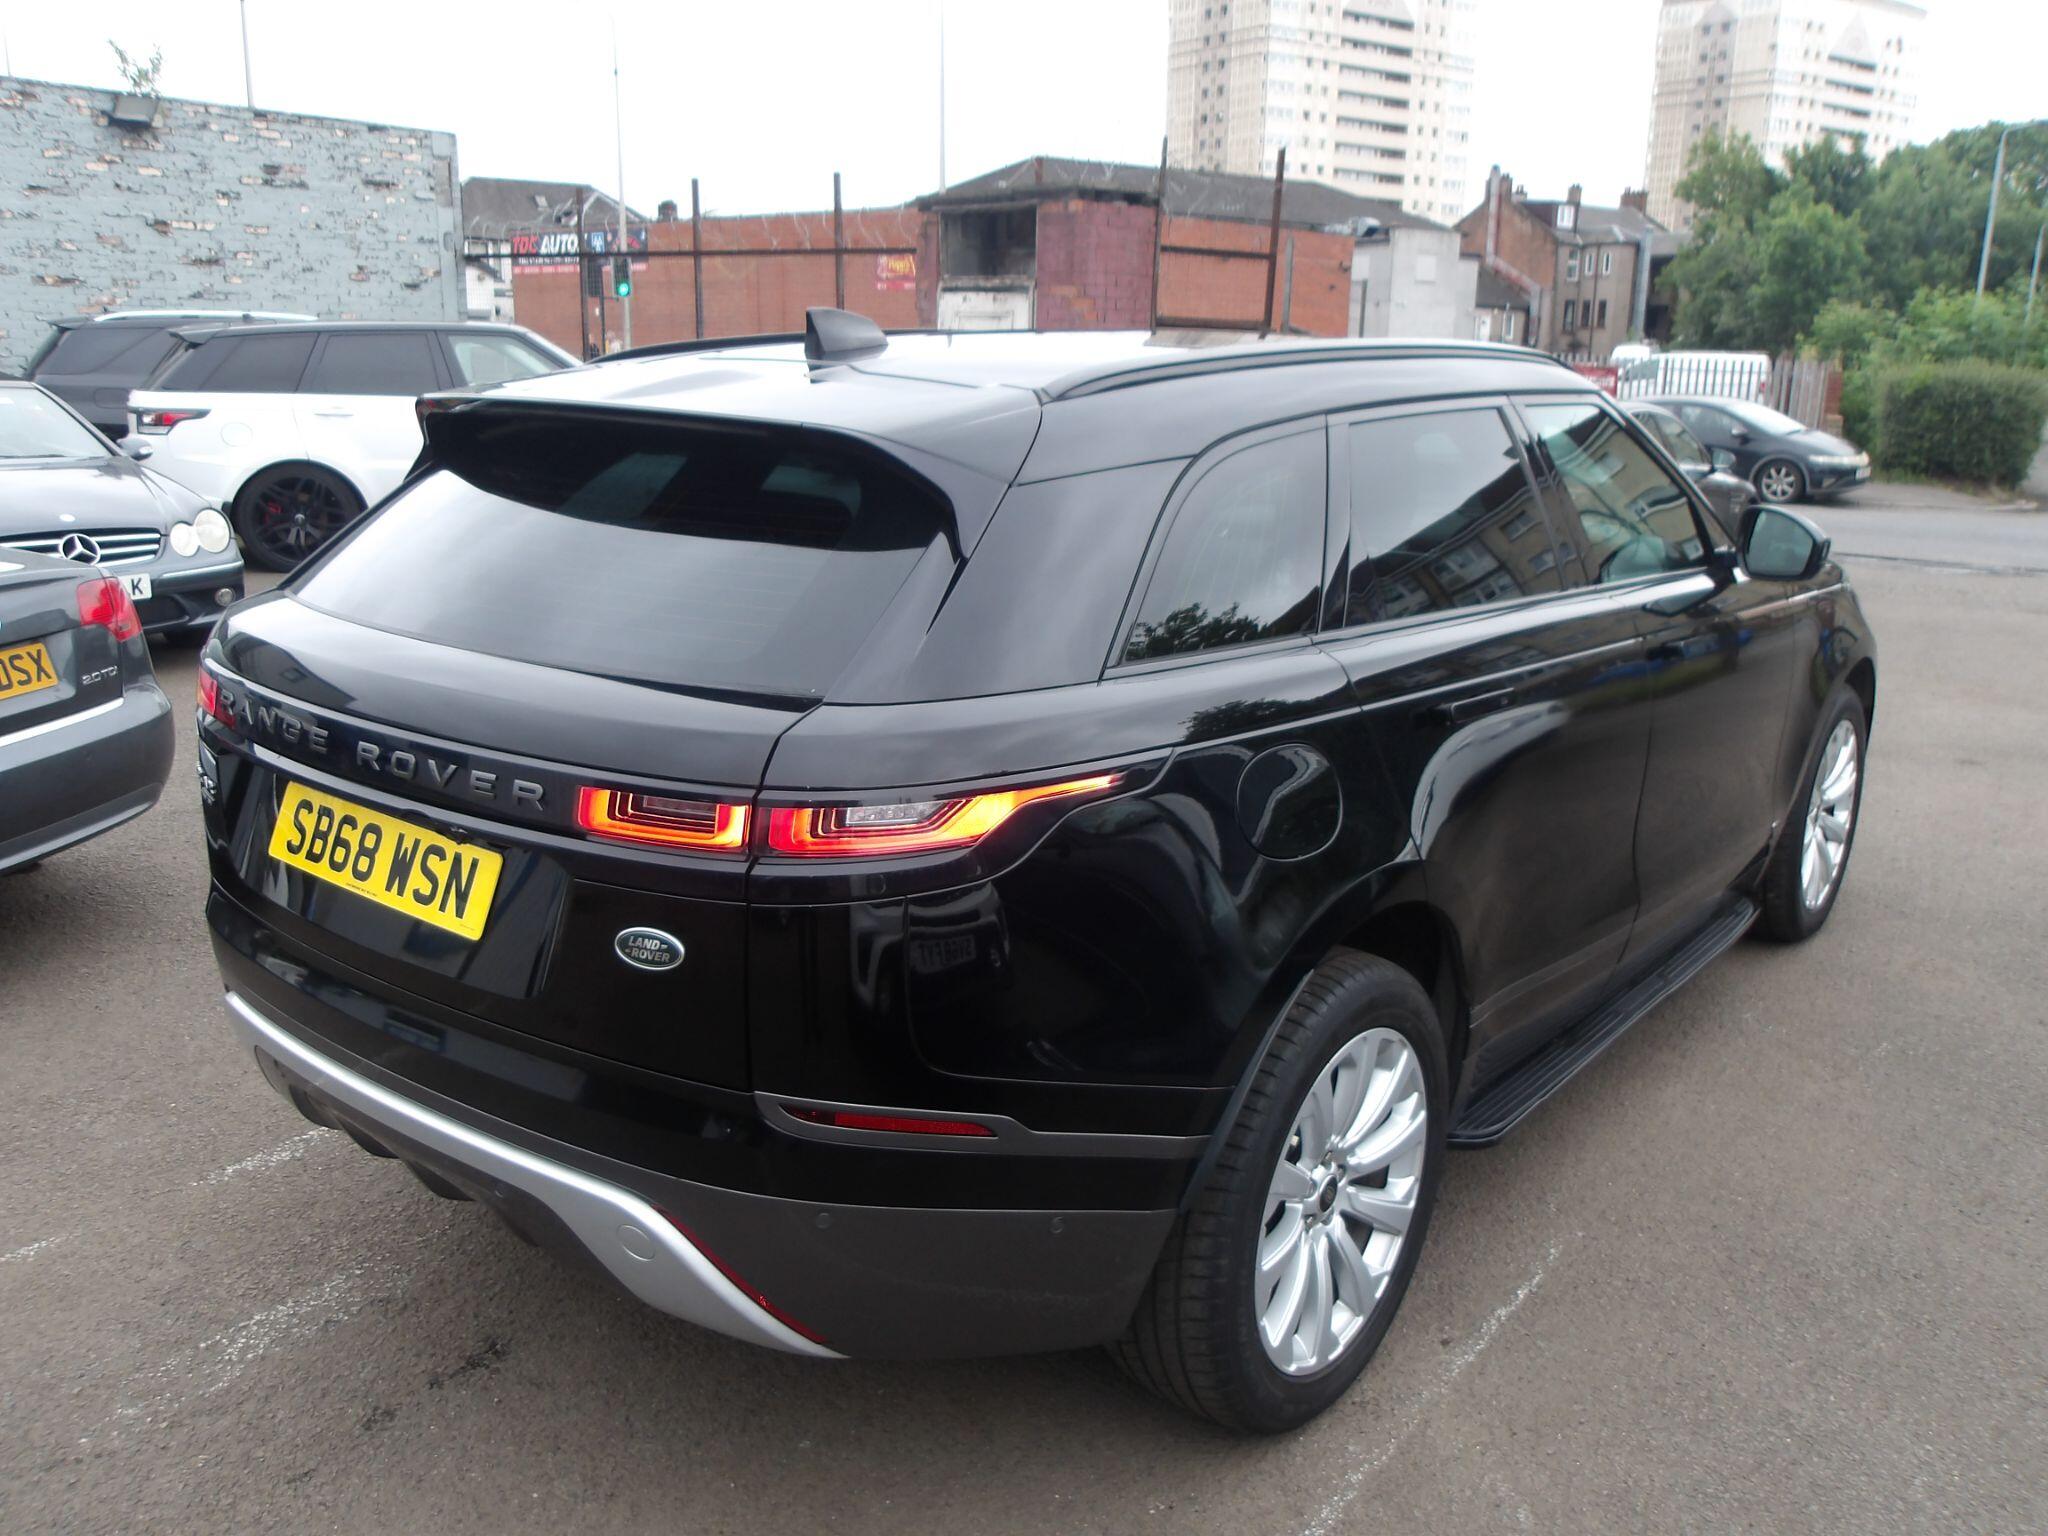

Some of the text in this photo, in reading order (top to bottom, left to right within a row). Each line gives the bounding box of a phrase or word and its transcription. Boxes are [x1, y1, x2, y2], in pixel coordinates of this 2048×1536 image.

[220, 687, 544, 811] RANGE ROVER
[286, 798, 480, 919] SB68 WSN
[628, 936, 661, 950] LAND
[630, 947, 671, 962] ROVER
